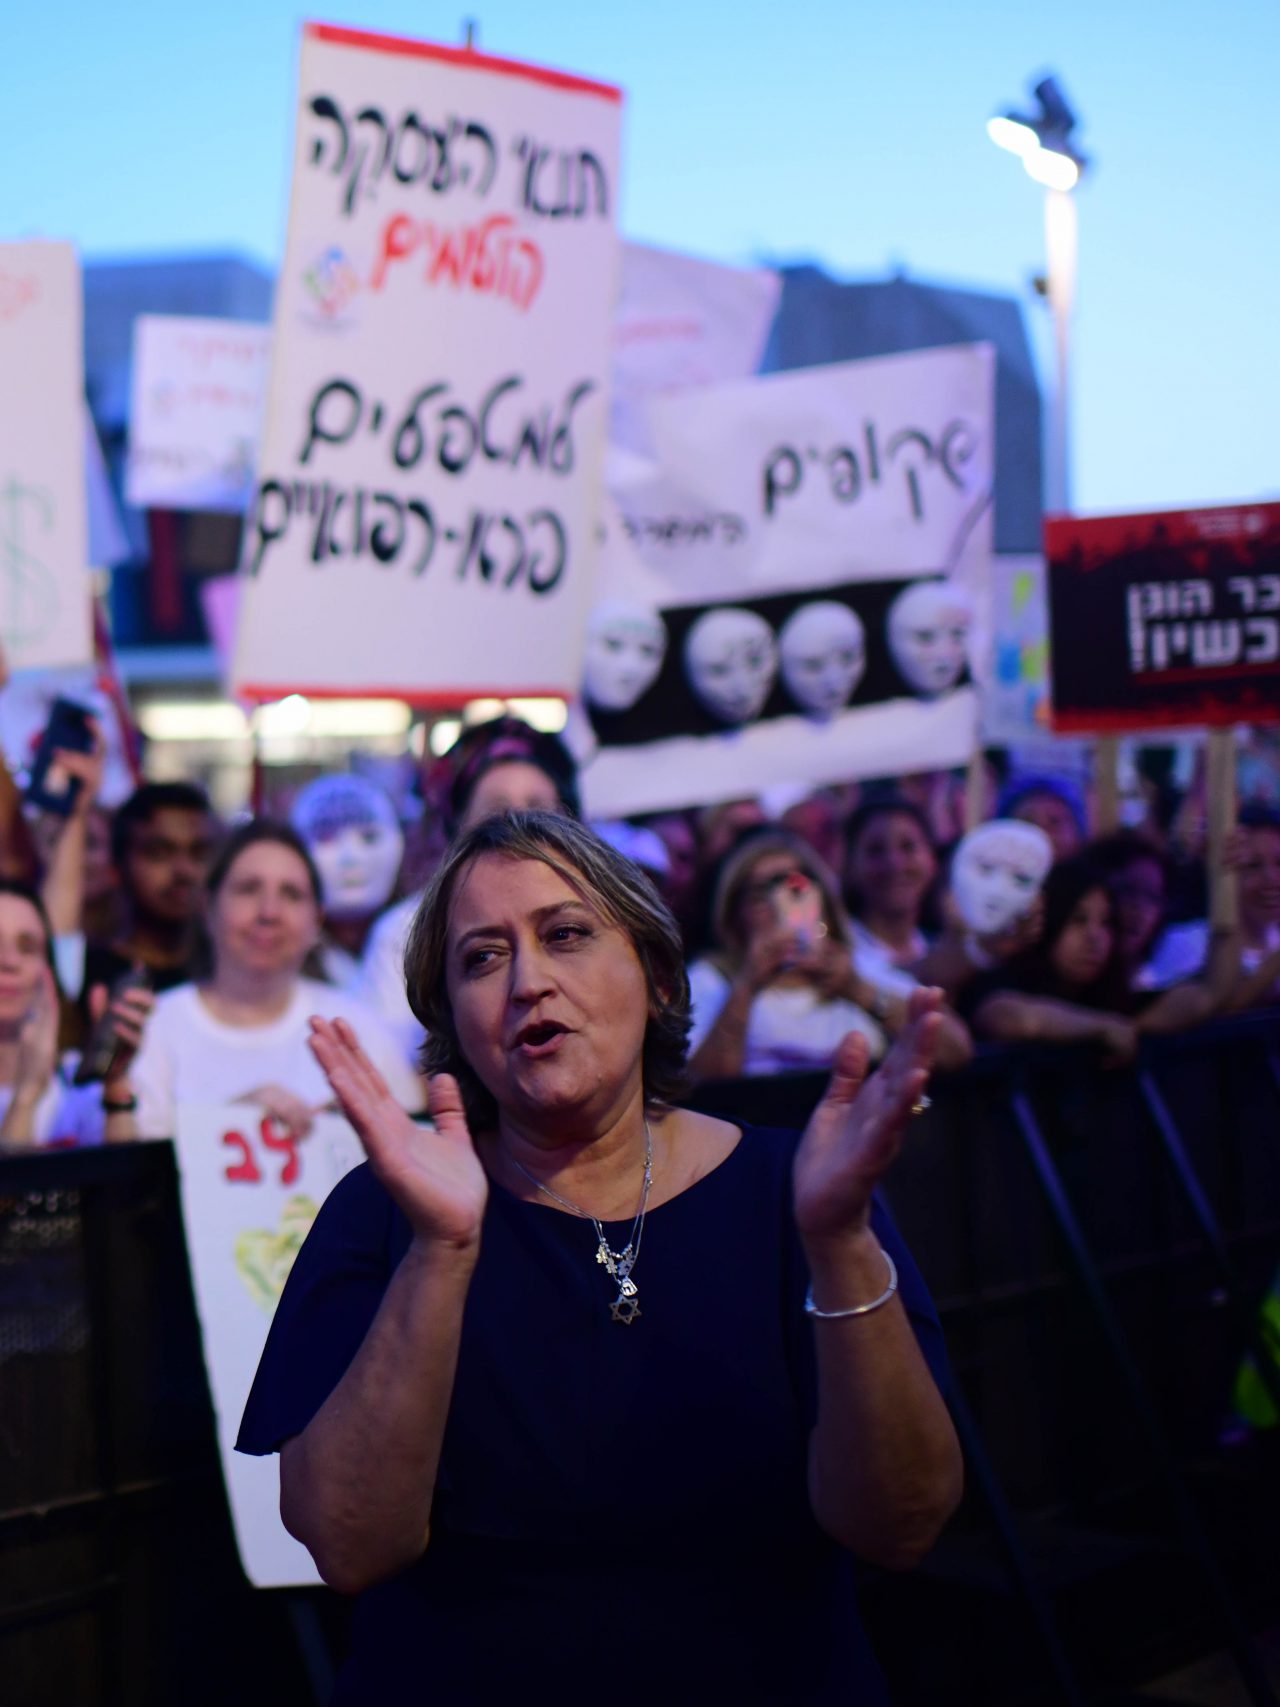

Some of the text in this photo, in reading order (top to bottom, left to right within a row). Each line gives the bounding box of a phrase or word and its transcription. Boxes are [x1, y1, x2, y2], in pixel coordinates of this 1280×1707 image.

[308, 95, 609, 218] תנאי העסקה
[297, 374, 596, 476] למטפלים
[764, 417, 980, 522] שקופים
